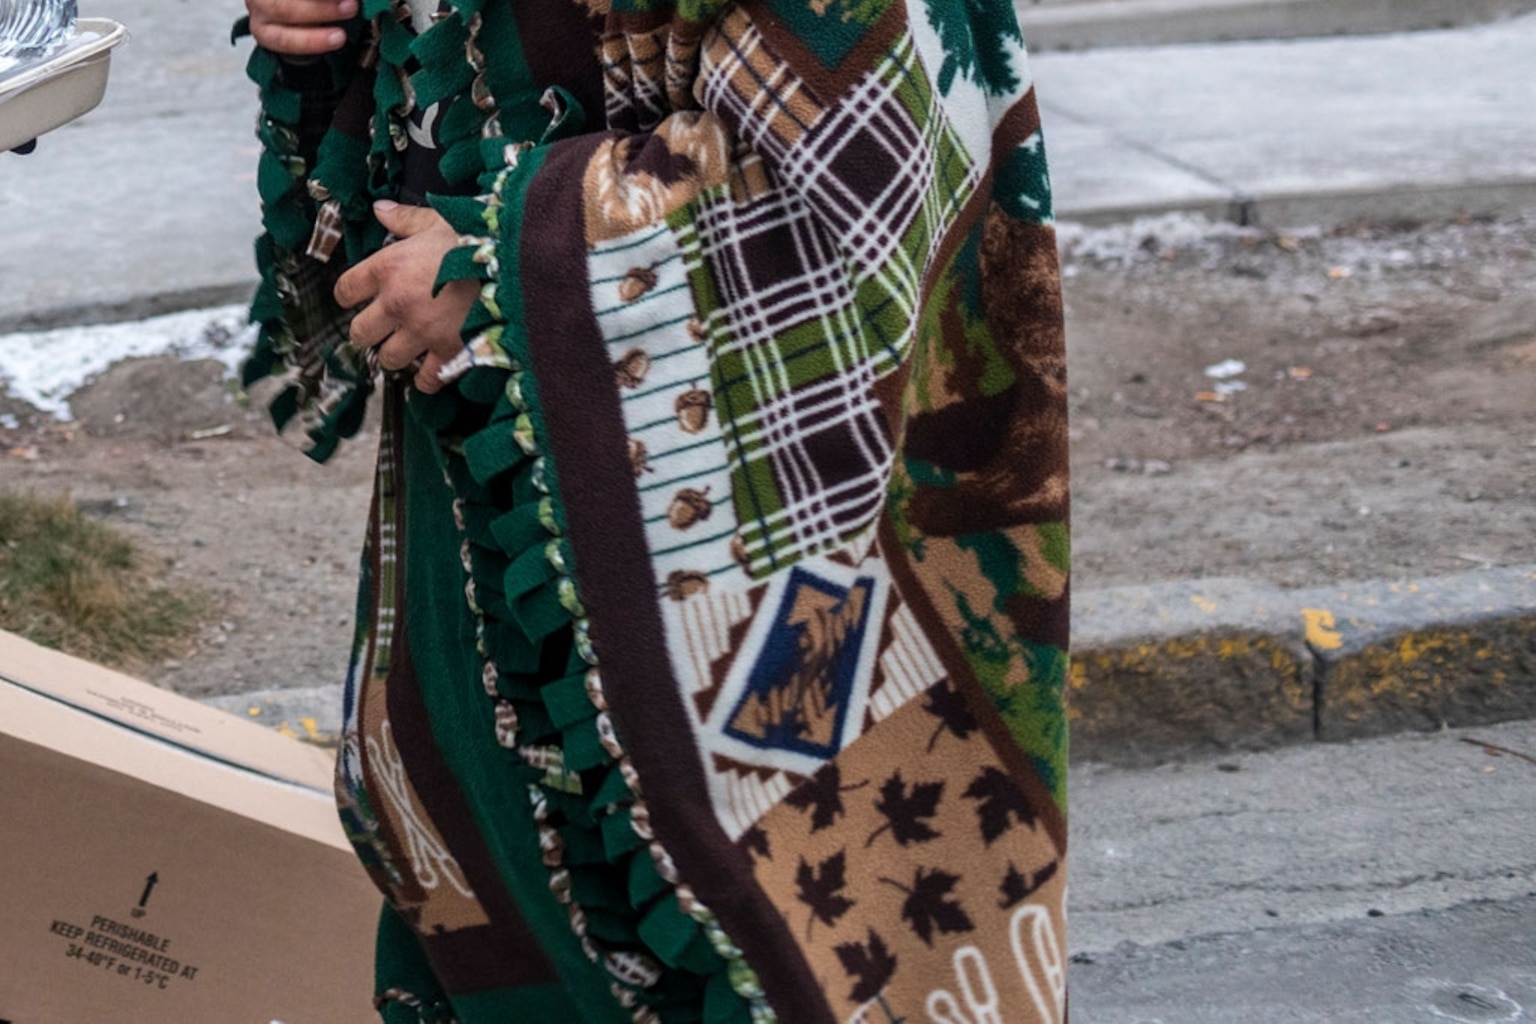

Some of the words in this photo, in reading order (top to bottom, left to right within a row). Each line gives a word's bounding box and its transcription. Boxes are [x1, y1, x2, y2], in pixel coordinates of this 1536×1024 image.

[49, 920, 85, 939] KEEP
[84, 931, 180, 974] REFRIGERATED
[179, 965, 199, 981] AT
[91, 915, 171, 953] PERISHABLE
[117, 963, 132, 976] or
